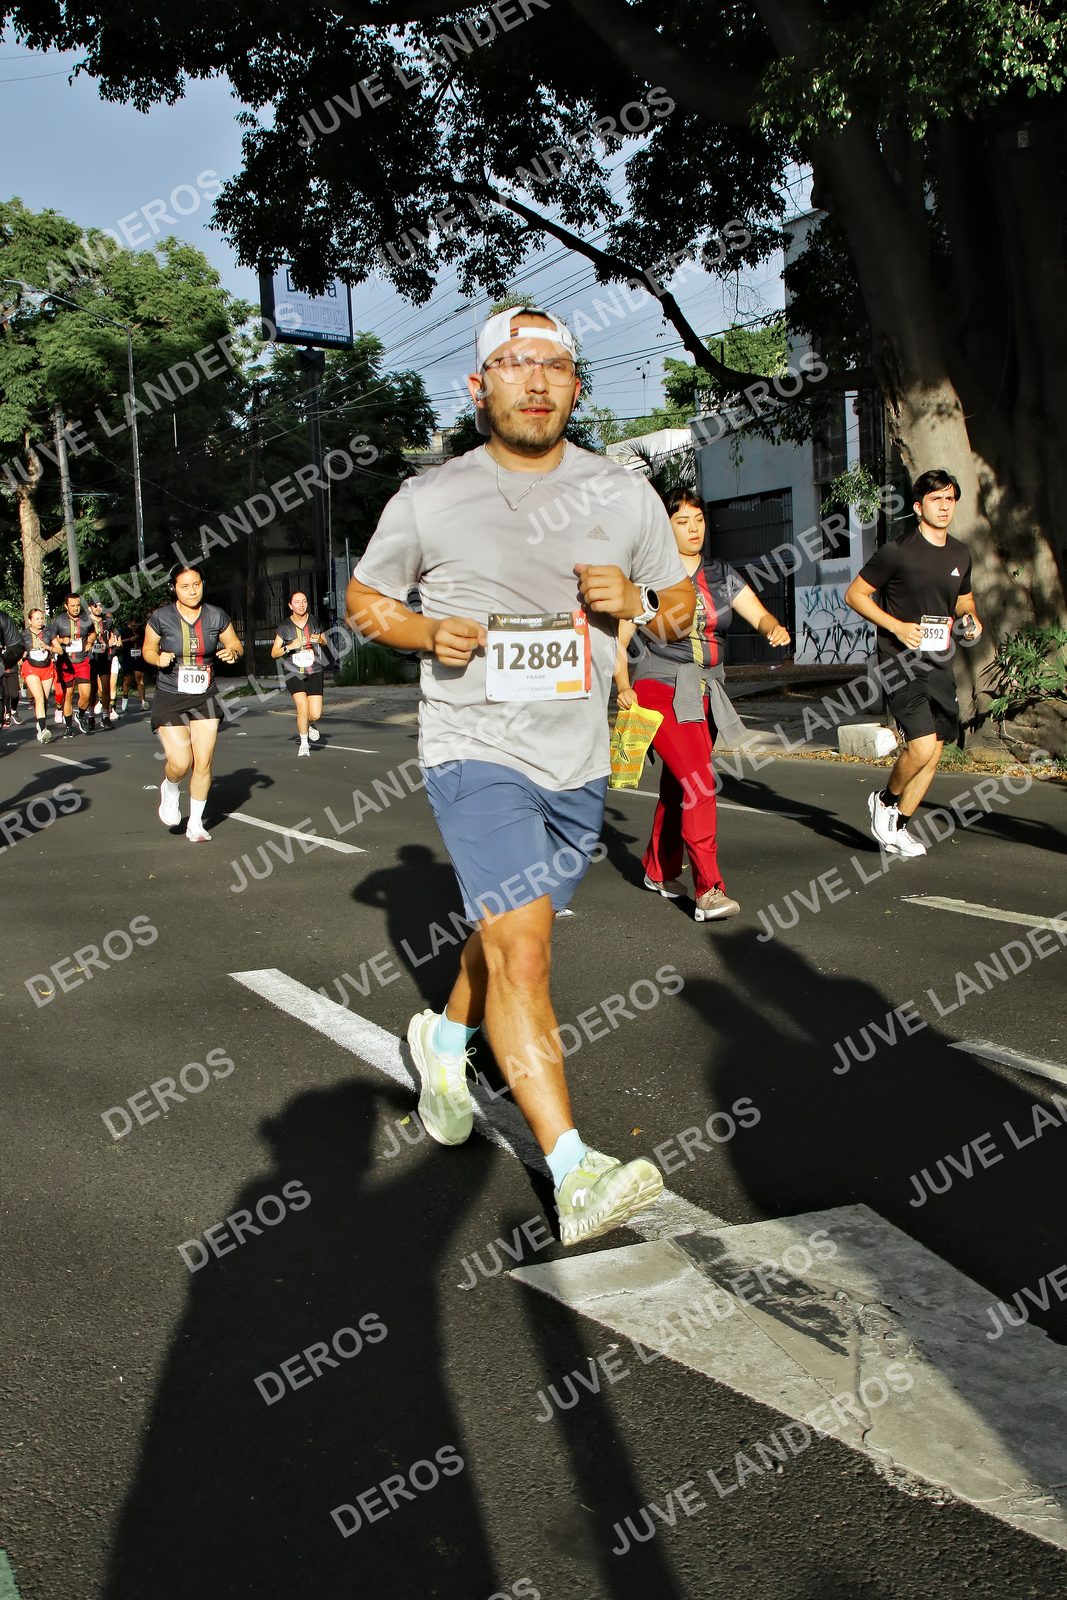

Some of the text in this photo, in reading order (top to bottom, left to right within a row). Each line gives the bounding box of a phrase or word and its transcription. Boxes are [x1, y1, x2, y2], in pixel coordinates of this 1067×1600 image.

[923, 627, 944, 640] 8592
[492, 640, 579, 670] 12884
[183, 674, 205, 684] 8109
